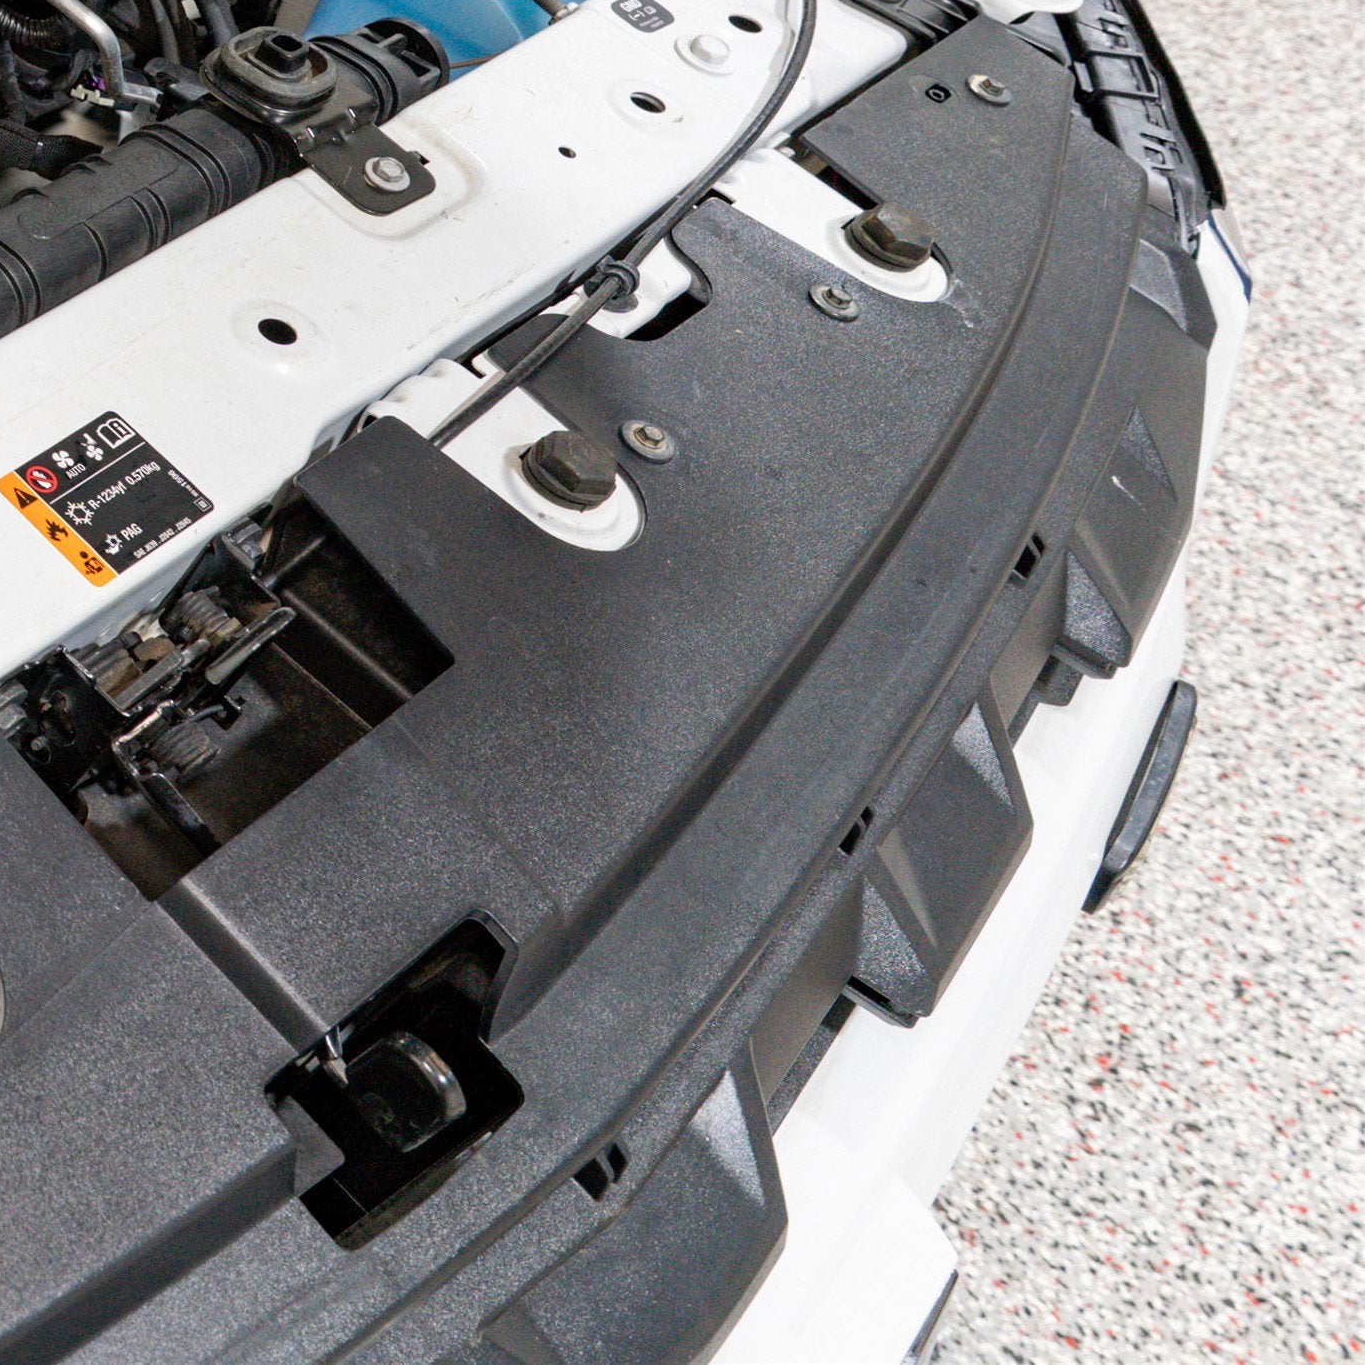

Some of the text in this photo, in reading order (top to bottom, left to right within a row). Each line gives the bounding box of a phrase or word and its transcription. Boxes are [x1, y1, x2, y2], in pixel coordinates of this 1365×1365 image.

[65, 462, 87, 480] AUTO
[87, 461, 162, 511] R-1234yf 0.570kg
[120, 522, 143, 542] PAG
